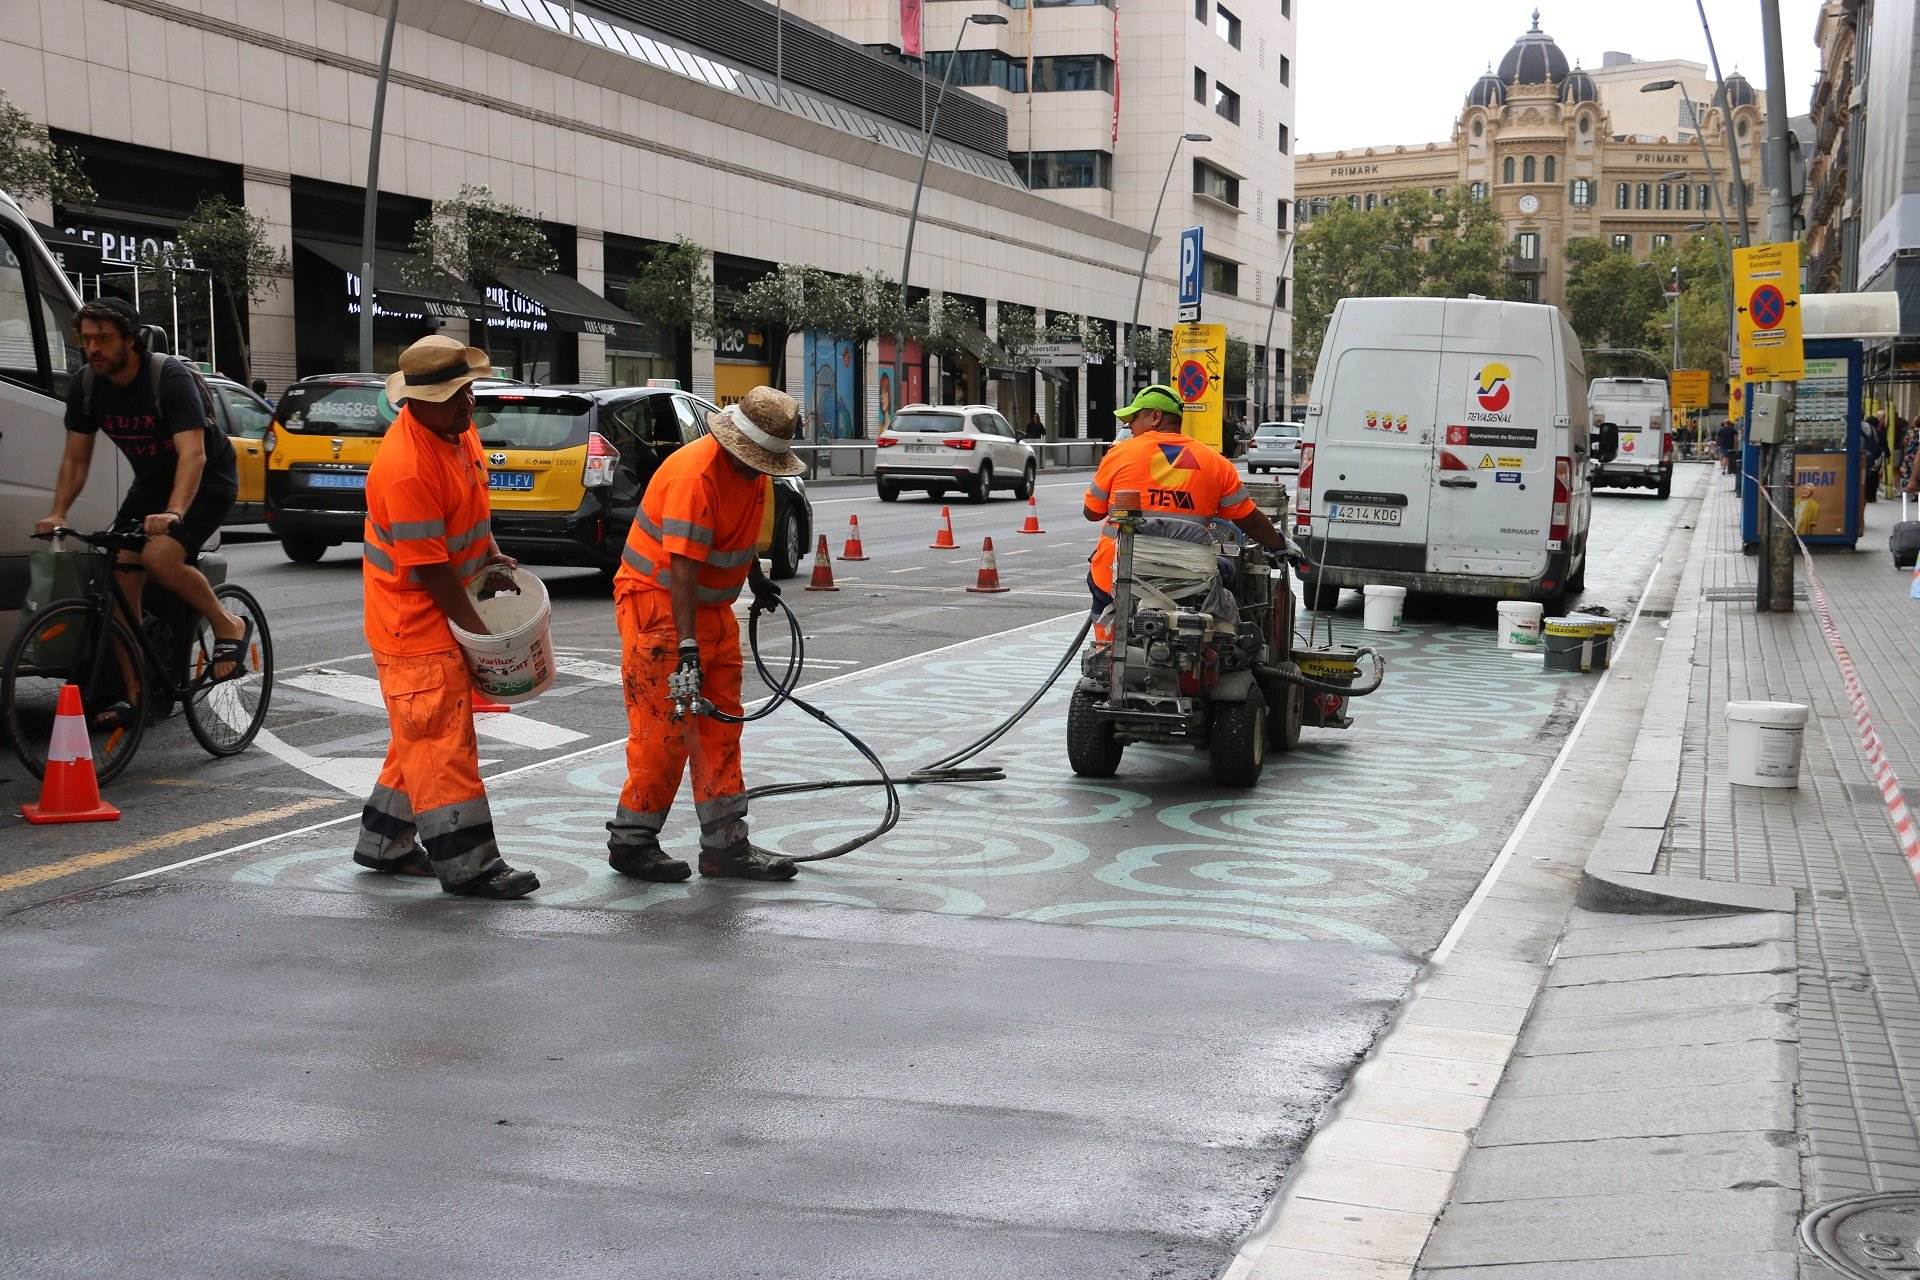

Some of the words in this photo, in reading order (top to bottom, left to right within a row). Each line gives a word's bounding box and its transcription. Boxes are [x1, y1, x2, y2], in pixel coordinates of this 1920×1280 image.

[1636, 153, 1689, 164] PRIMARK
[1330, 165, 1378, 176] PRIMARK
[64, 226, 196, 270] PHORA
[1181, 237, 1195, 296] P
[713, 328, 745, 353] nac
[1469, 432, 1500, 440] Ajuntament
[507, 474, 531, 487] LFV
[1796, 471, 1838, 487] JUGAT
[1148, 489, 1195, 510] TEVA
[1339, 507, 1369, 519] 4214
[1373, 508, 1397, 521] KDG
[1500, 528, 1540, 536] RENAULT
[478, 656, 516, 667] Varilux
